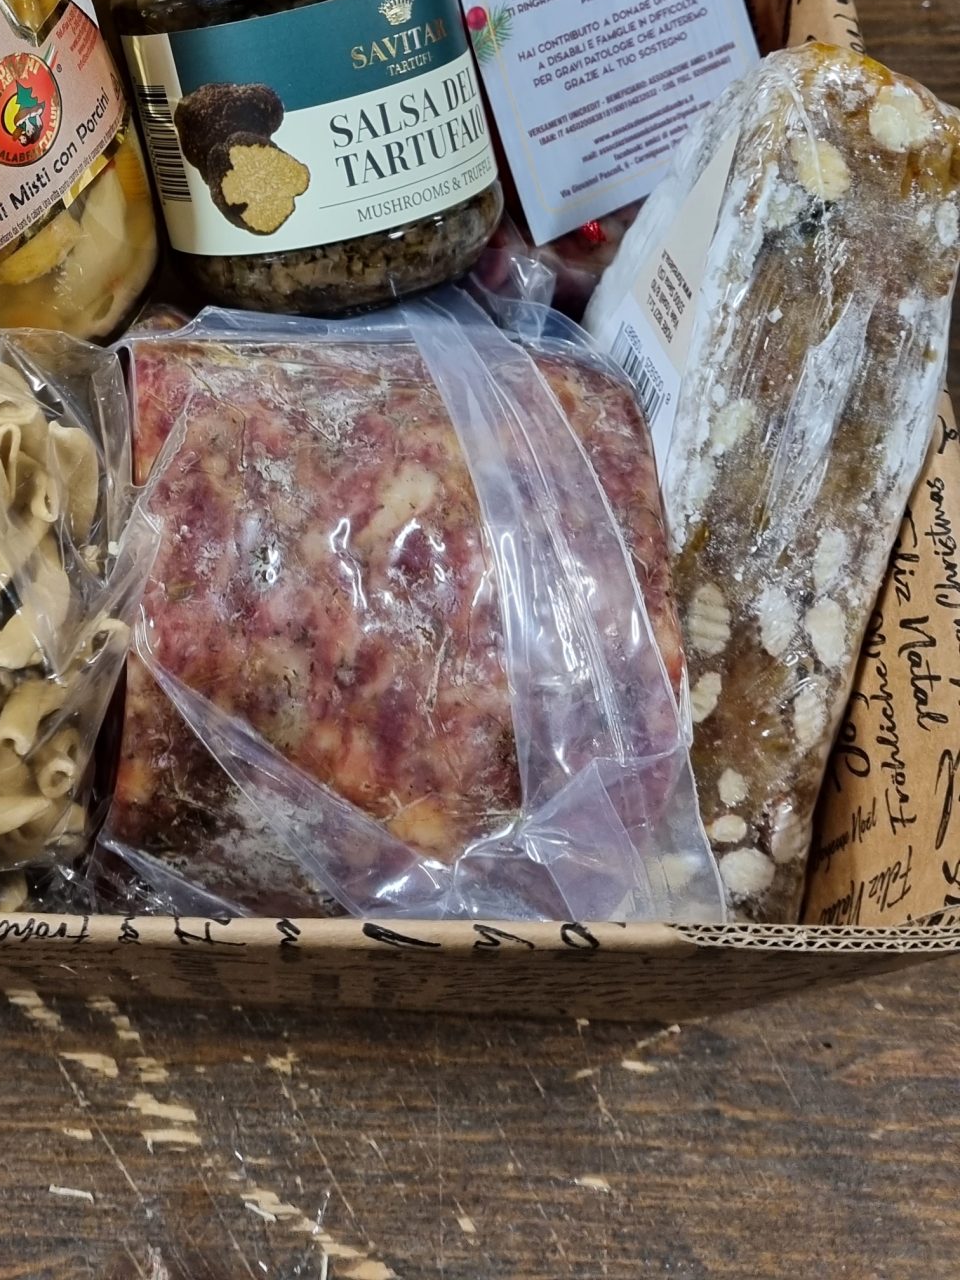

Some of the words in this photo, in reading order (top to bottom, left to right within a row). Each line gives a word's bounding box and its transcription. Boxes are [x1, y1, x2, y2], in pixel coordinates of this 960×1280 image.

[506, 6, 516, 17] TI
[517, 47, 536, 62] HAI
[536, 19, 601, 54] CONTRIBUITO
[602, 17, 610, 27] A
[611, 0, 652, 23] DONARE
[387, 52, 432, 77] TARTUFI
[532, 72, 553, 88] PER
[554, 59, 583, 78] GRAVI
[583, 37, 635, 66] PATOLOGIE
[636, 28, 656, 44] CHE
[536, 60, 545, 70] A
[546, 41, 586, 66] DISABILI
[586, 38, 594, 49] E
[594, 20, 636, 46] FAMIGLIE
[637, 16, 648, 27] IN
[562, 68, 600, 91] GRAZIE
[600, 62, 614, 75] AL
[616, 52, 637, 68] TUO
[637, 30, 688, 58] SOSTEGNO
[329, 86, 441, 149] SALSA
[442, 67, 477, 112] DEL
[8, 168, 51, 211] Misti
[52, 149, 79, 175] con
[75, 87, 110, 146] Porcini
[335, 103, 486, 188] TARTUFAIO
[357, 180, 451, 223] MUSHROOMS
[451, 176, 462, 191] &
[898, 616, 949, 731] Natal
[868, 657, 917, 835] Fröhliche
[868, 844, 913, 912] Feliz
